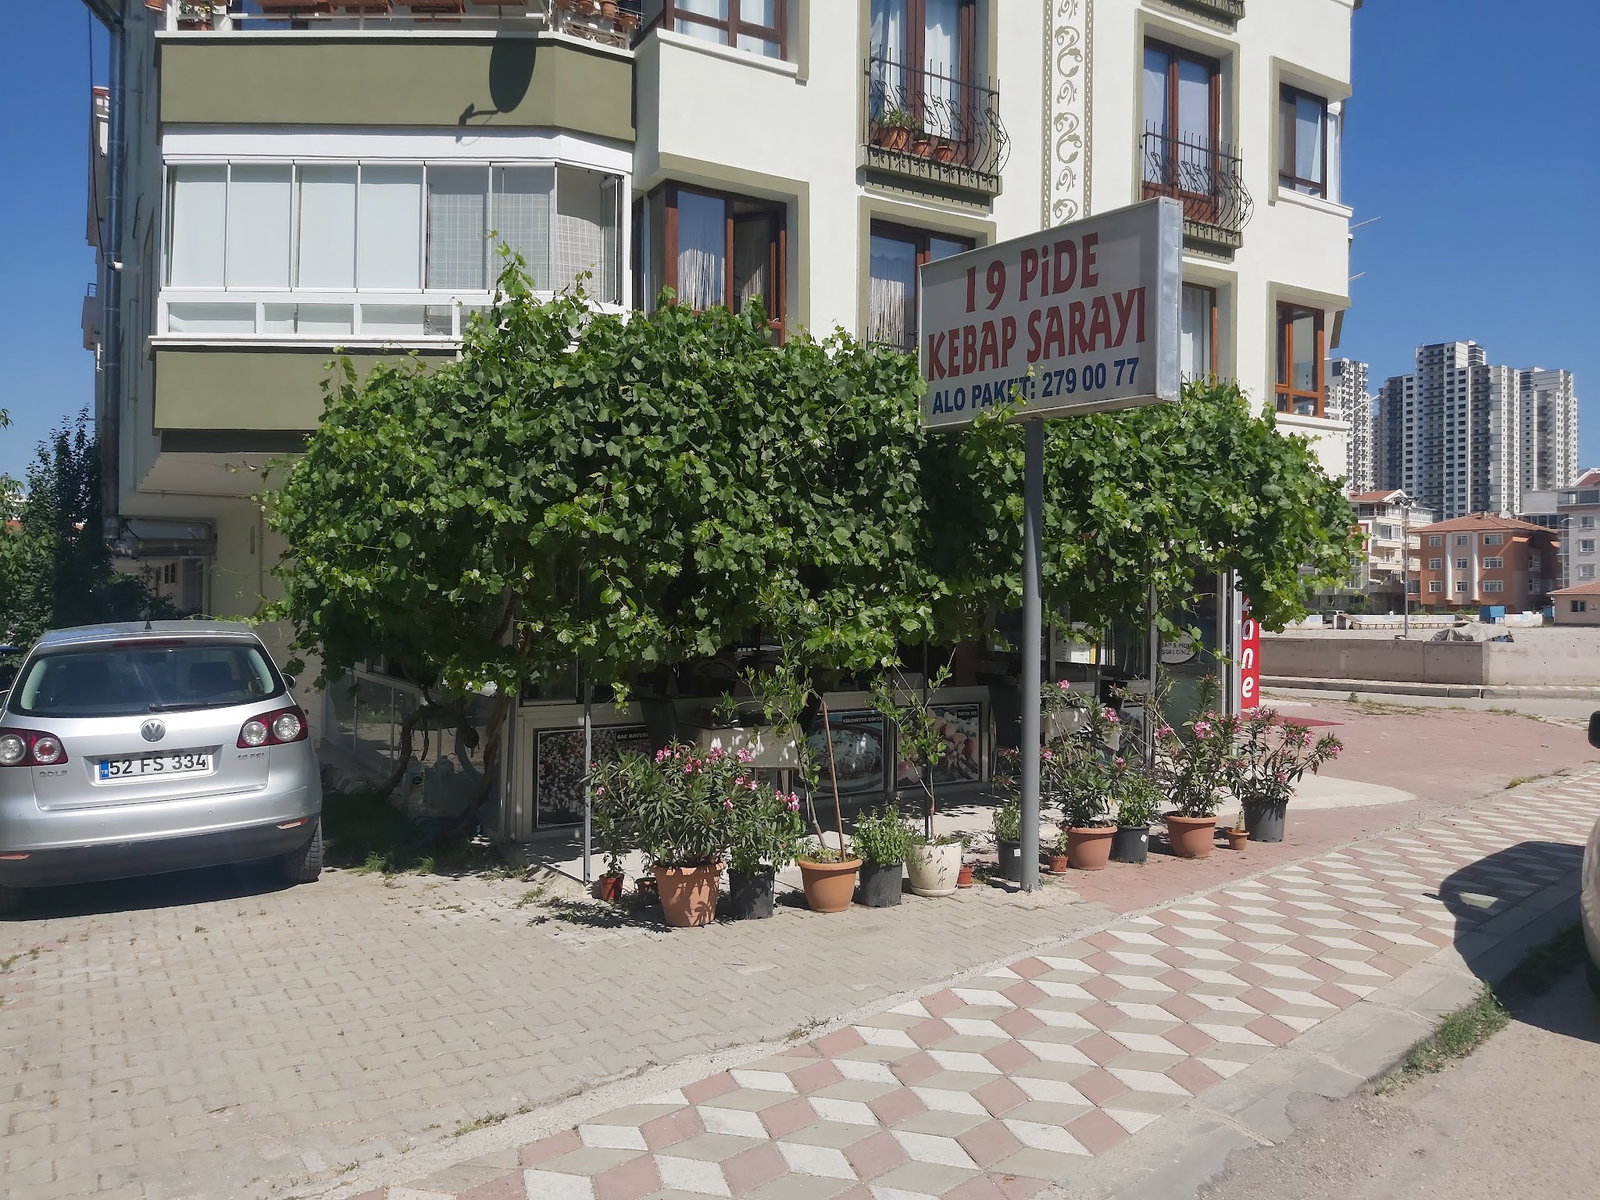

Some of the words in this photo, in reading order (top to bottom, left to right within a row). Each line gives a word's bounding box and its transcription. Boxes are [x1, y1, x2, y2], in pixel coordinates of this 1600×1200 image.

[928, 314, 1017, 382] KEBAP
[1026, 286, 1147, 363] SARAYI
[932, 387, 966, 415] ALO
[1042, 369, 1077, 398] 279
[1082, 363, 1106, 391] 00
[1113, 356, 1140, 386] 77
[39, 770, 67, 778] GOLF
[109, 760, 133, 776] 52
[140, 757, 165, 773] FS
[171, 753, 207, 771] 334
